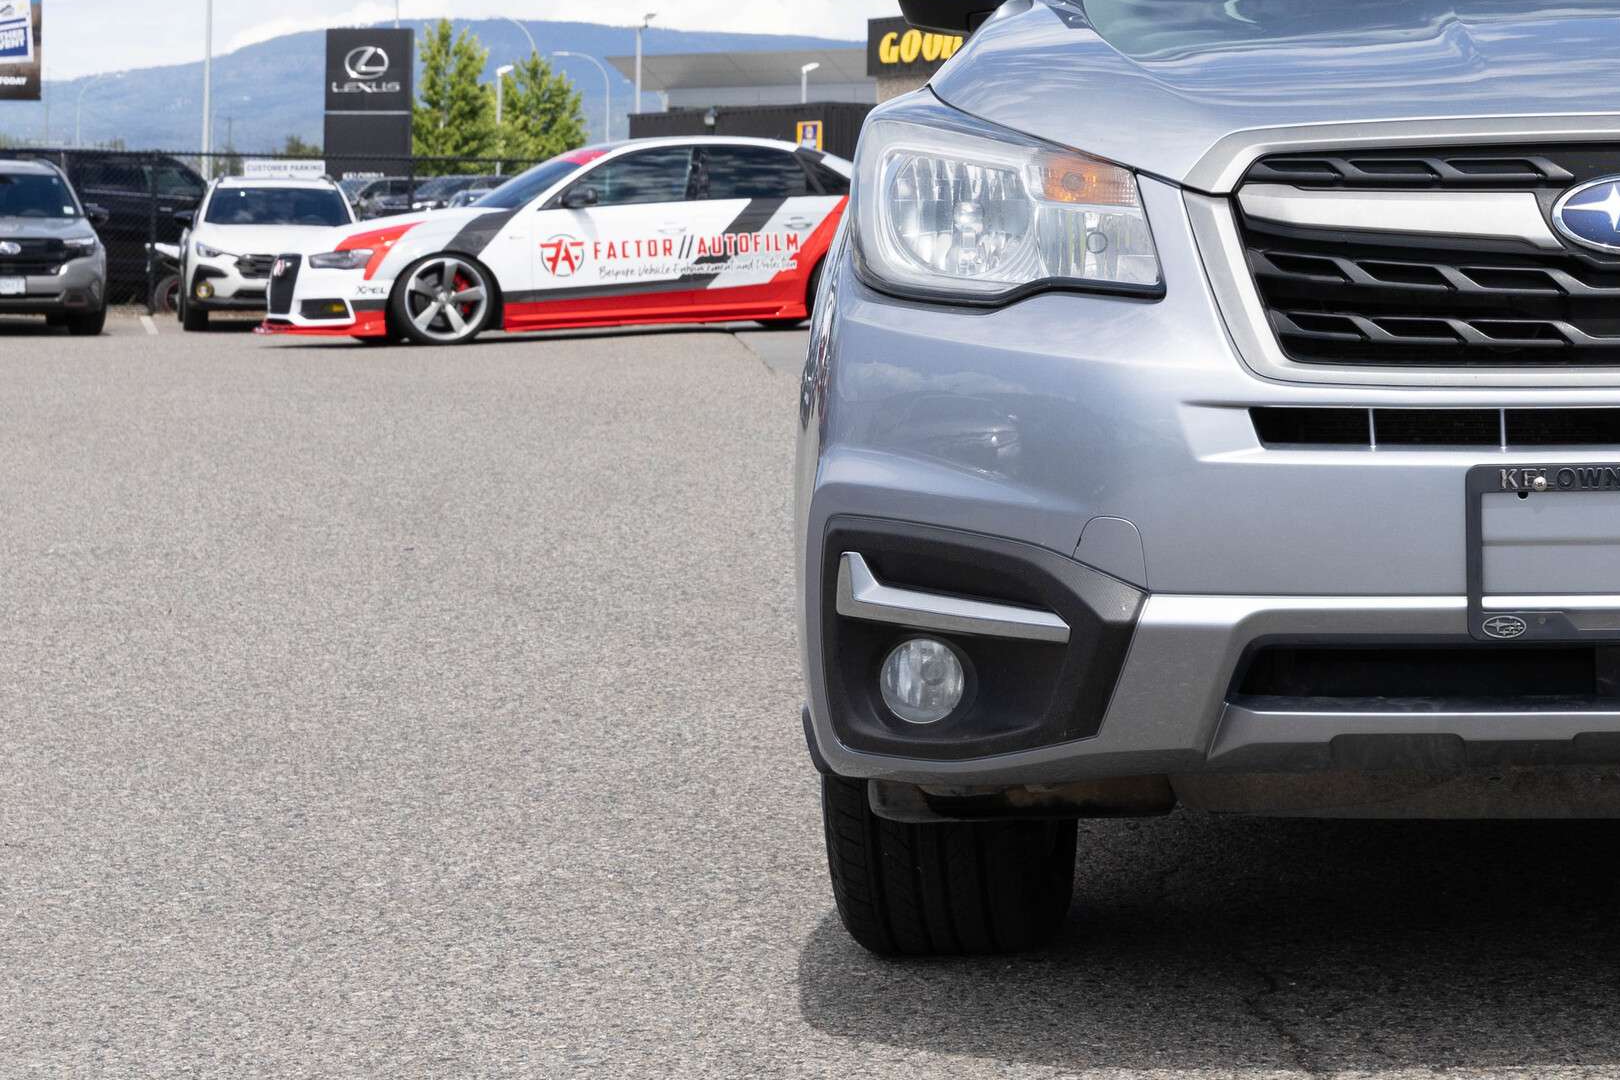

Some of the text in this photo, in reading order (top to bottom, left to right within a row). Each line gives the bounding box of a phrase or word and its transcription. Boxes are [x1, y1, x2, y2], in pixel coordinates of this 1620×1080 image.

[332, 82, 400, 93] LEXUS
[247, 163, 323, 172] CUSTOMER PARKING
[594, 238, 673, 260] FACTOR
